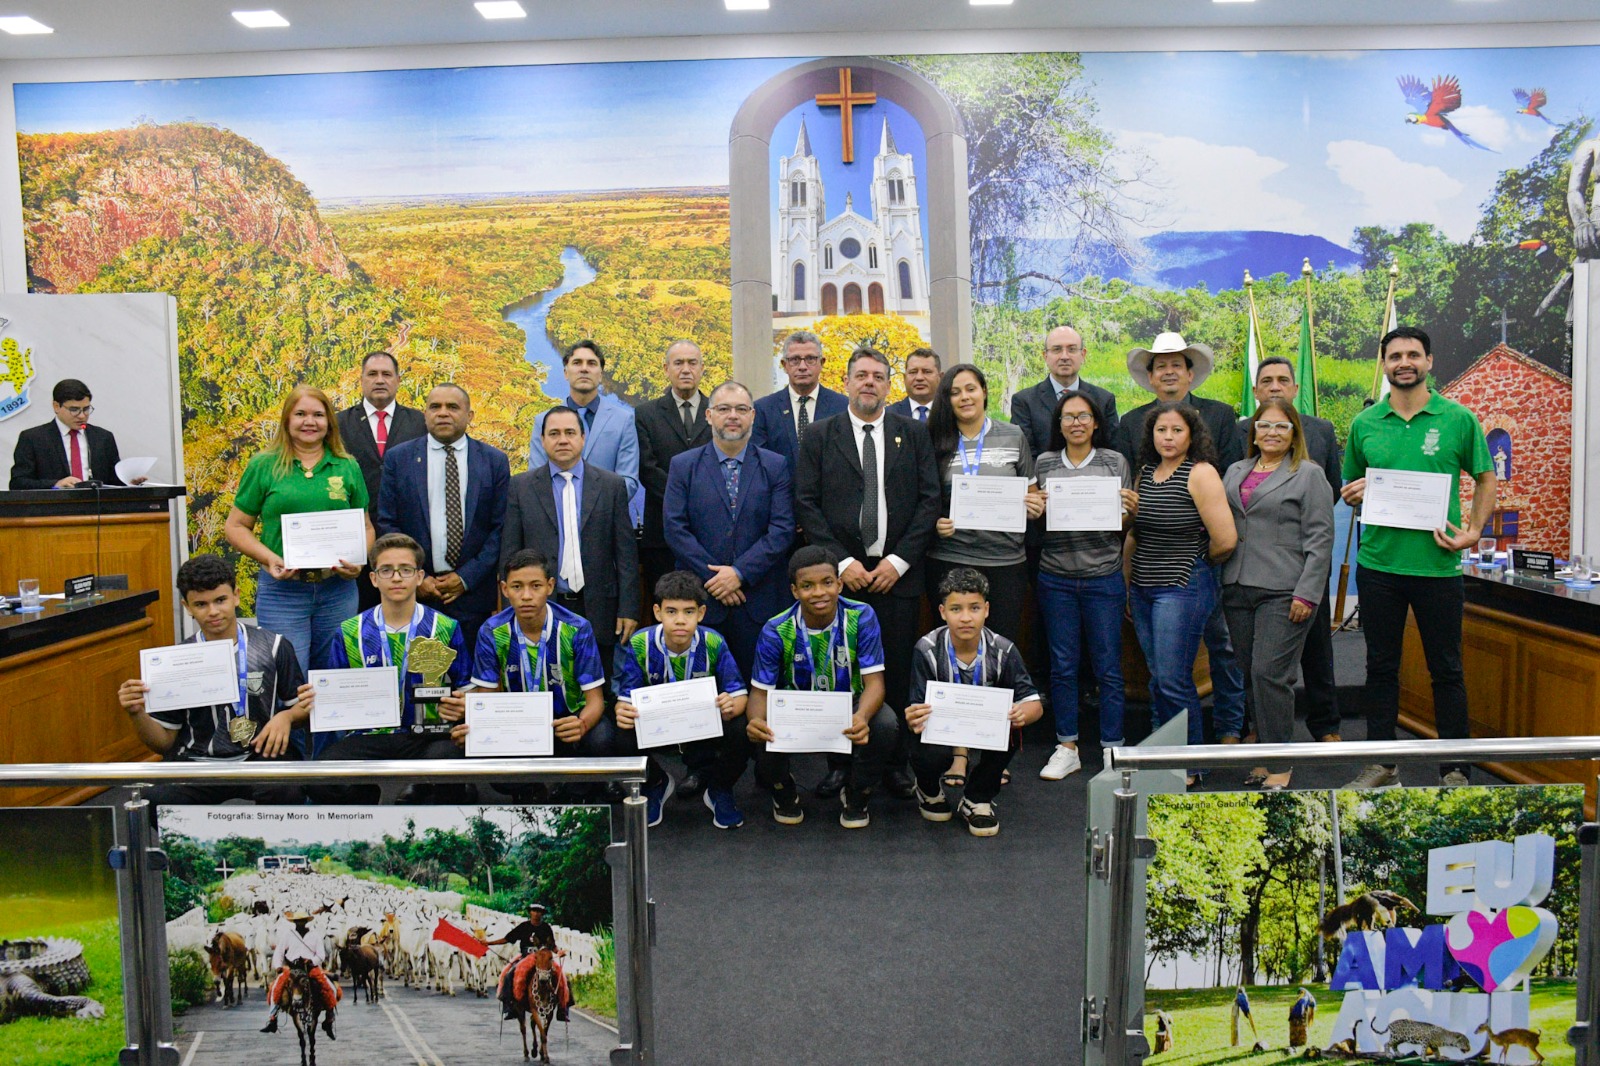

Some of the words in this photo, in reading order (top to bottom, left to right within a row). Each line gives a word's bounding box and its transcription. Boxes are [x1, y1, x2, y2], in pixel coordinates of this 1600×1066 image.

[1, 397, 26, 414] 1892
[207, 812, 255, 821] Fotografia:
[257, 812, 284, 821] Sirnay
[287, 812, 310, 820] Moro
[317, 812, 326, 820] In
[328, 812, 374, 820] Memoriam
[1426, 834, 1556, 916] EU
